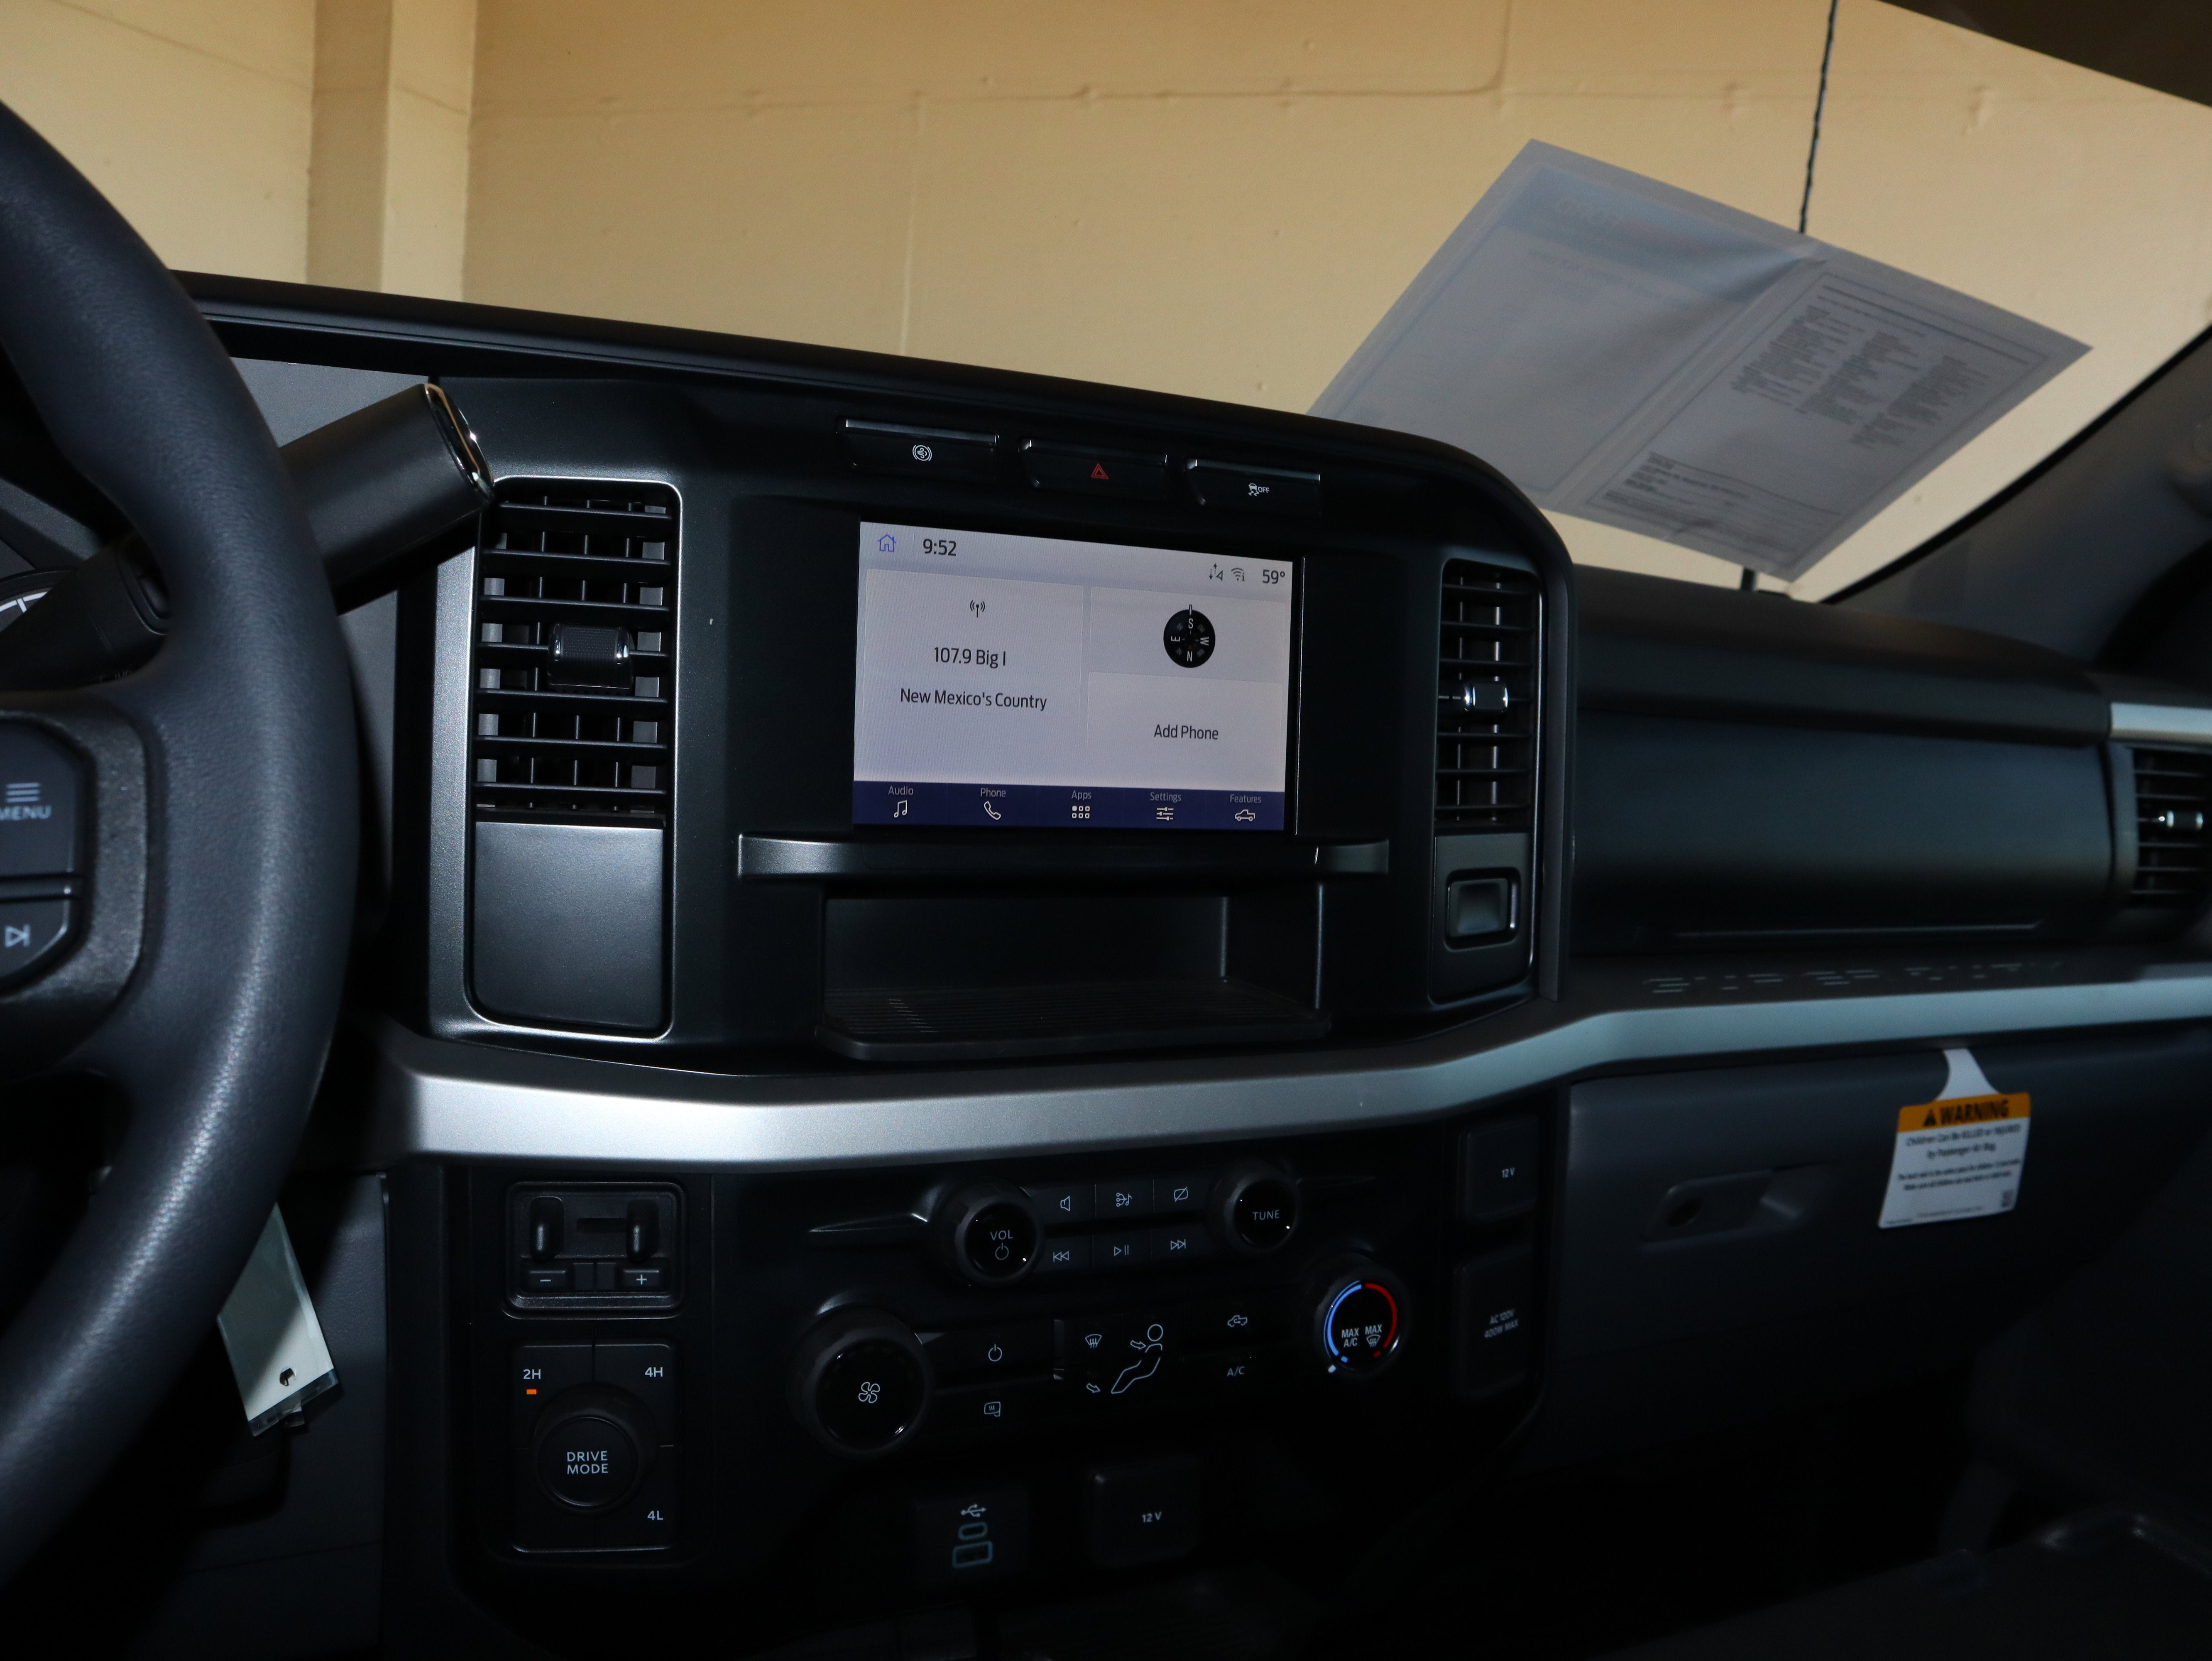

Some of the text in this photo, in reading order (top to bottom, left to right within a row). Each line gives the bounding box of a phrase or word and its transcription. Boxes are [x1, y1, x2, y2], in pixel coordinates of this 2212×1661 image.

[923, 538, 957, 556] 9:52
[1262, 569, 1285, 584] 59°
[1188, 618, 1194, 629] S
[934, 647, 971, 664] 107.9
[976, 649, 998, 669] Big
[1187, 651, 1193, 661] N
[900, 688, 1047, 711] New Mexico's Country
[1154, 724, 1219, 740] Add Phone
[888, 785, 914, 795] Audio
[980, 787, 1006, 797] Phone
[1071, 790, 1092, 801] Apps
[1150, 792, 1182, 803] Settings
[1230, 794, 1262, 803] Features
[1940, 1100, 2009, 1124] WARNING
[1501, 1167, 1515, 1178] 12 V
[1253, 1210, 1279, 1220] TUNE
[990, 1230, 1013, 1241] VOL
[1365, 1323, 1382, 1335] MAX
[1504, 1318, 1519, 1332] MAX
[1341, 1328, 1359, 1338] MAX
[1343, 1337, 1358, 1348] A/C
[523, 1369, 541, 1379] 2H
[644, 1367, 663, 1377] 4H
[1227, 1366, 1245, 1377] A/C
[567, 1450, 608, 1462] DRIVE
[567, 1463, 608, 1474] MODE
[647, 1510, 663, 1521] 4L
[1142, 1512, 1162, 1522] 12 V
